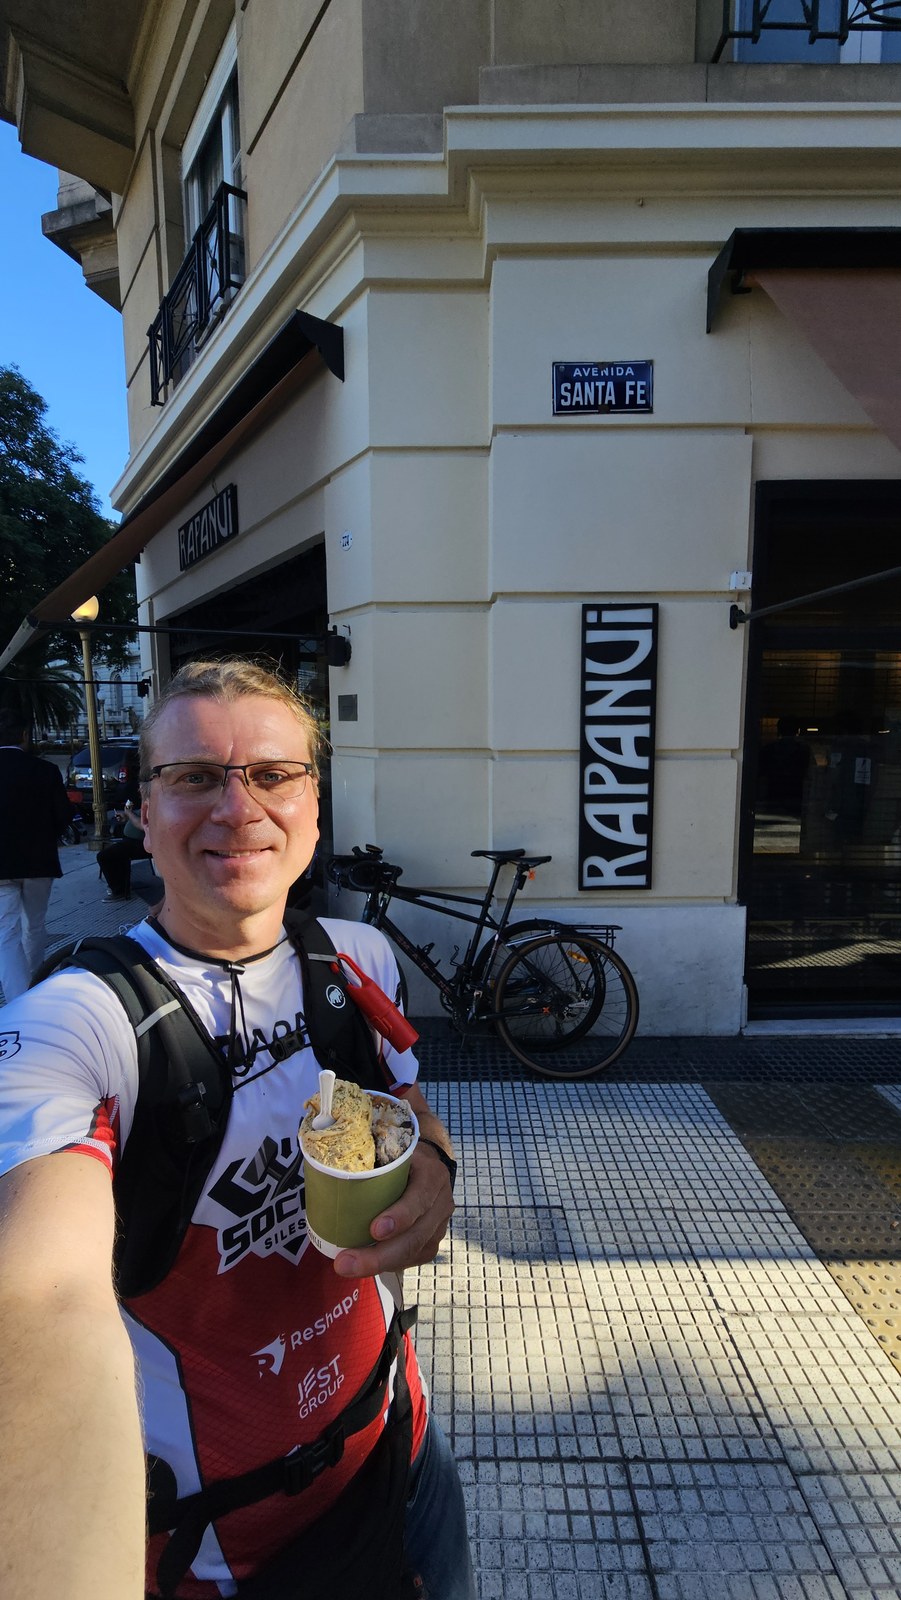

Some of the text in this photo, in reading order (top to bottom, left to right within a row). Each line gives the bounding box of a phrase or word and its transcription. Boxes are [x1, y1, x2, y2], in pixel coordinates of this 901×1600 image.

[560, 380, 647, 406] SANTA FE
[573, 366, 635, 378] AVENIDA
[290, 1288, 360, 1351] ReShape
[297, 1354, 341, 1406] JEST
[299, 1374, 345, 1420] GROUP
